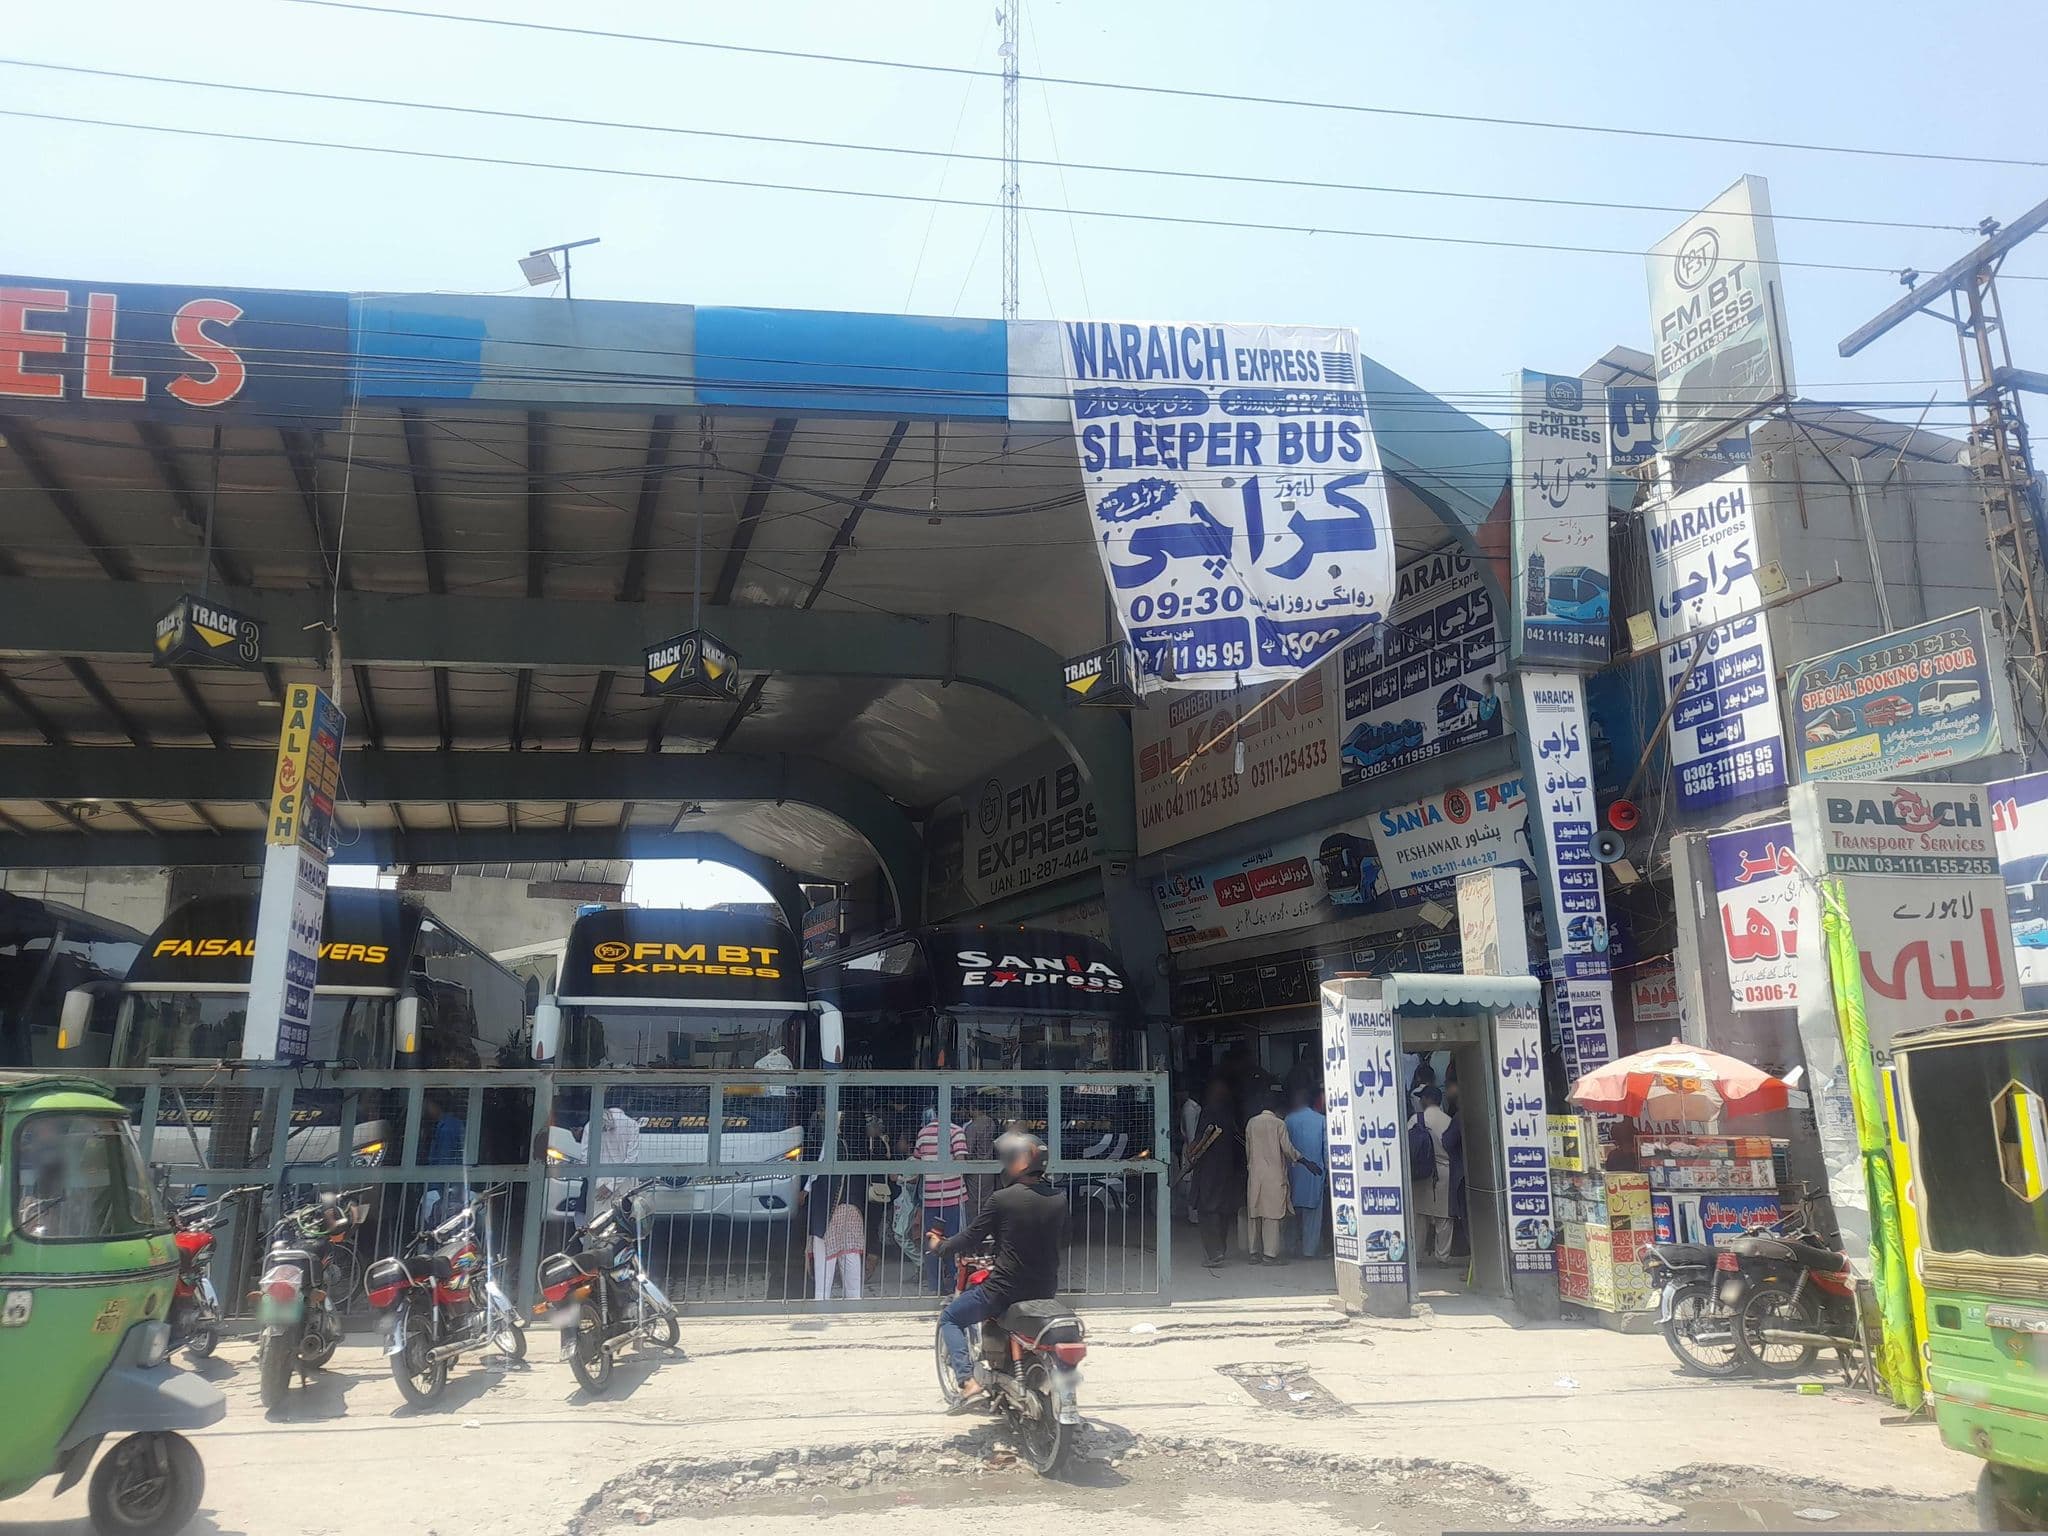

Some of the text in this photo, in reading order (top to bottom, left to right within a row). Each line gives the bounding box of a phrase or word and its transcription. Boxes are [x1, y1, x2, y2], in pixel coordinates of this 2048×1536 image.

[1660, 262, 1746, 342] FM BT
[1660, 290, 1754, 366] EXPRESS
[1067, 322, 1321, 382] WARAICH EXPRESS
[1668, 352, 1688, 373] UAN
[1528, 421, 1602, 444] EXPRESS
[1541, 410, 1590, 428] FM BT
[1083, 420, 1363, 472] SLEEPER BUS
[1550, 451, 1599, 508] فیصل
[1103, 471, 1377, 589] کراچی
[1651, 487, 1747, 554] WARAICH
[1702, 519, 1747, 549] Express
[1400, 546, 1472, 603] ARAIC
[1659, 537, 1753, 618] کراچی
[1130, 585, 1244, 622] 09:30
[1316, 585, 1375, 611] روانگی
[1440, 589, 1490, 636] کراچی
[192, 604, 260, 663] TRACK 3
[1466, 635, 1495, 669] سکھر
[1527, 626, 1606, 649] 042 111-287-444
[648, 638, 697, 679] TRACK 2
[1064, 655, 1102, 682] TRACK
[1105, 647, 1120, 685] 1
[1196, 640, 1245, 668] 95 95
[1804, 627, 1972, 691] RAHBER
[1533, 690, 1574, 705] WARAICH
[1801, 646, 1977, 713] SPECIAL BOOKING & TOUR
[1170, 692, 1213, 729] RAHBER
[1557, 704, 1575, 714] Express
[1360, 742, 1441, 780] 0302-1119595
[1538, 721, 1580, 764] کراچی
[1683, 744, 1773, 782] 0302-111 95 95
[1684, 759, 1775, 796] 0348-111 55 95
[1006, 776, 1048, 831] FM
[1055, 762, 1081, 810] B
[1141, 738, 1328, 830] UAN: 042 111 254 333 0311-1254333
[1545, 771, 1587, 794] صادق
[1552, 791, 1582, 817] آباد
[977, 801, 1099, 880] EXPRESS
[1396, 823, 1502, 865] PESHAWAR پشاور
[990, 847, 1090, 897] UAN: 111-287-444
[1410, 850, 1498, 881] Mob: 03-111-444-287
[1833, 856, 1992, 875] UAN 03-111-155-255
[1925, 890, 1975, 920] لاہور
[152, 939, 256, 958] FAISAL
[633, 942, 705, 961] FM
[717, 944, 780, 964] BT
[956, 950, 1120, 978] SANIA
[591, 963, 782, 979] EXPRESS
[1569, 989, 1601, 1000] WARAICH
[1745, 983, 1798, 1003] 0306-2
[1349, 1012, 1392, 1028] WARAICH
[1575, 1006, 1602, 1030] کراچی
[1325, 1022, 1346, 1077] کراچی
[1501, 1037, 1540, 1083] کراچی
[1354, 1045, 1394, 1104] کراچی
[1327, 1086, 1349, 1113] صادق
[1503, 1091, 1543, 1116] صادق
[1331, 1109, 1347, 1141] آباد
[1356, 1115, 1397, 1146] صادق
[1510, 1112, 1539, 1141] آباد
[1363, 1141, 1392, 1178] آباد
